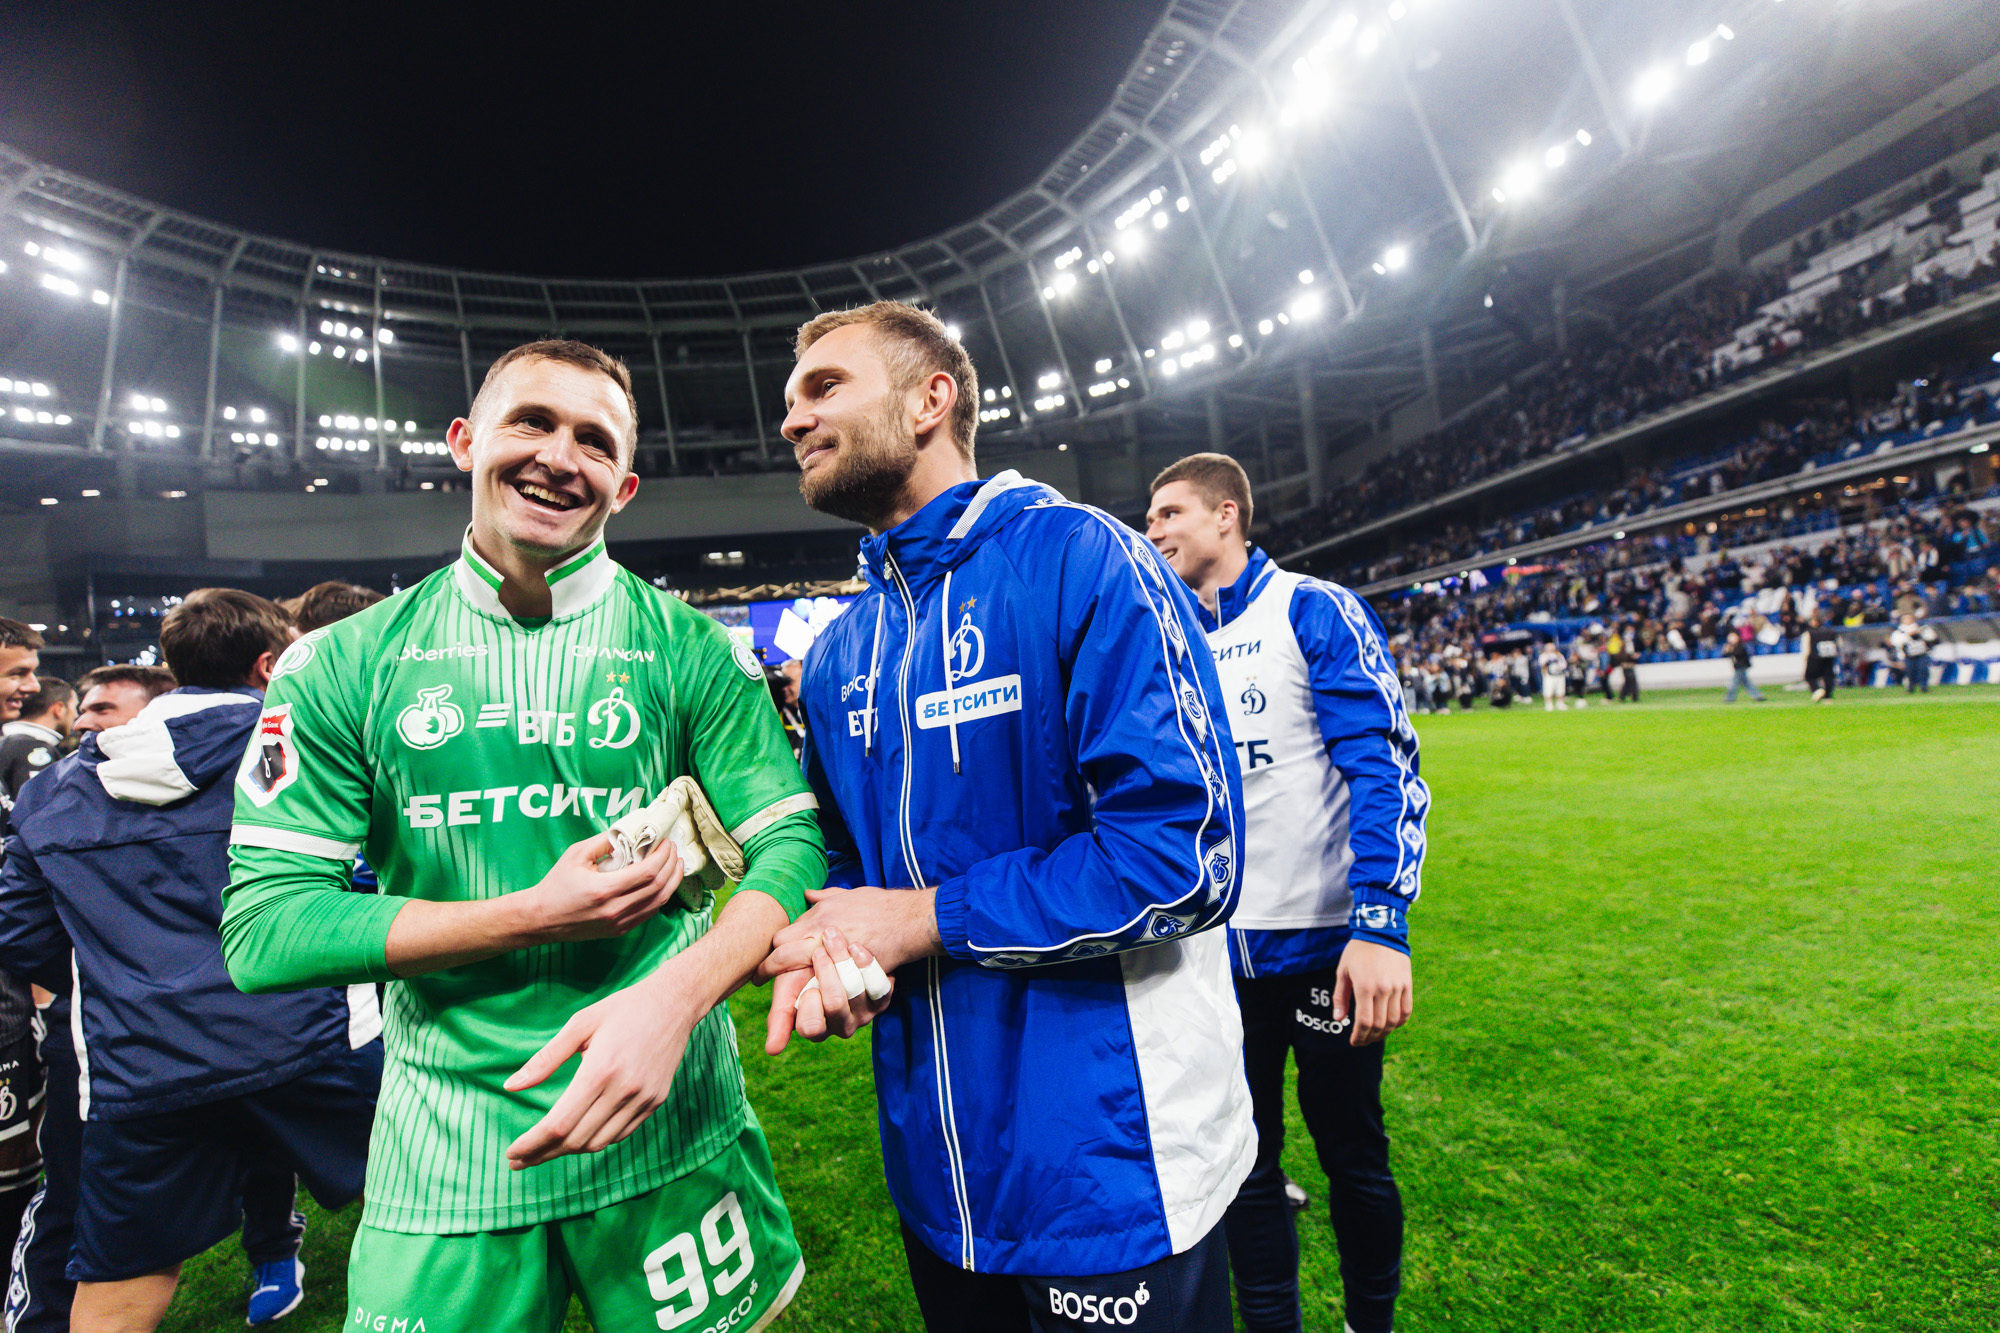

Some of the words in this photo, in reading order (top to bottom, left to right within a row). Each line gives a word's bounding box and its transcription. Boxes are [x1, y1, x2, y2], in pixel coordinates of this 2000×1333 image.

[571, 645, 655, 662] CHANGAN
[923, 684, 1019, 719] БЕТСИТИ
[517, 710, 576, 747] ВТБ
[403, 783, 646, 828] БЕТСИТИ
[1310, 987, 1331, 1007] 56
[1296, 1008, 1344, 1035] BOSCO
[643, 1190, 755, 1331] 99
[355, 1306, 426, 1333] DIGMA
[1049, 1287, 1138, 1325] BOSCO
